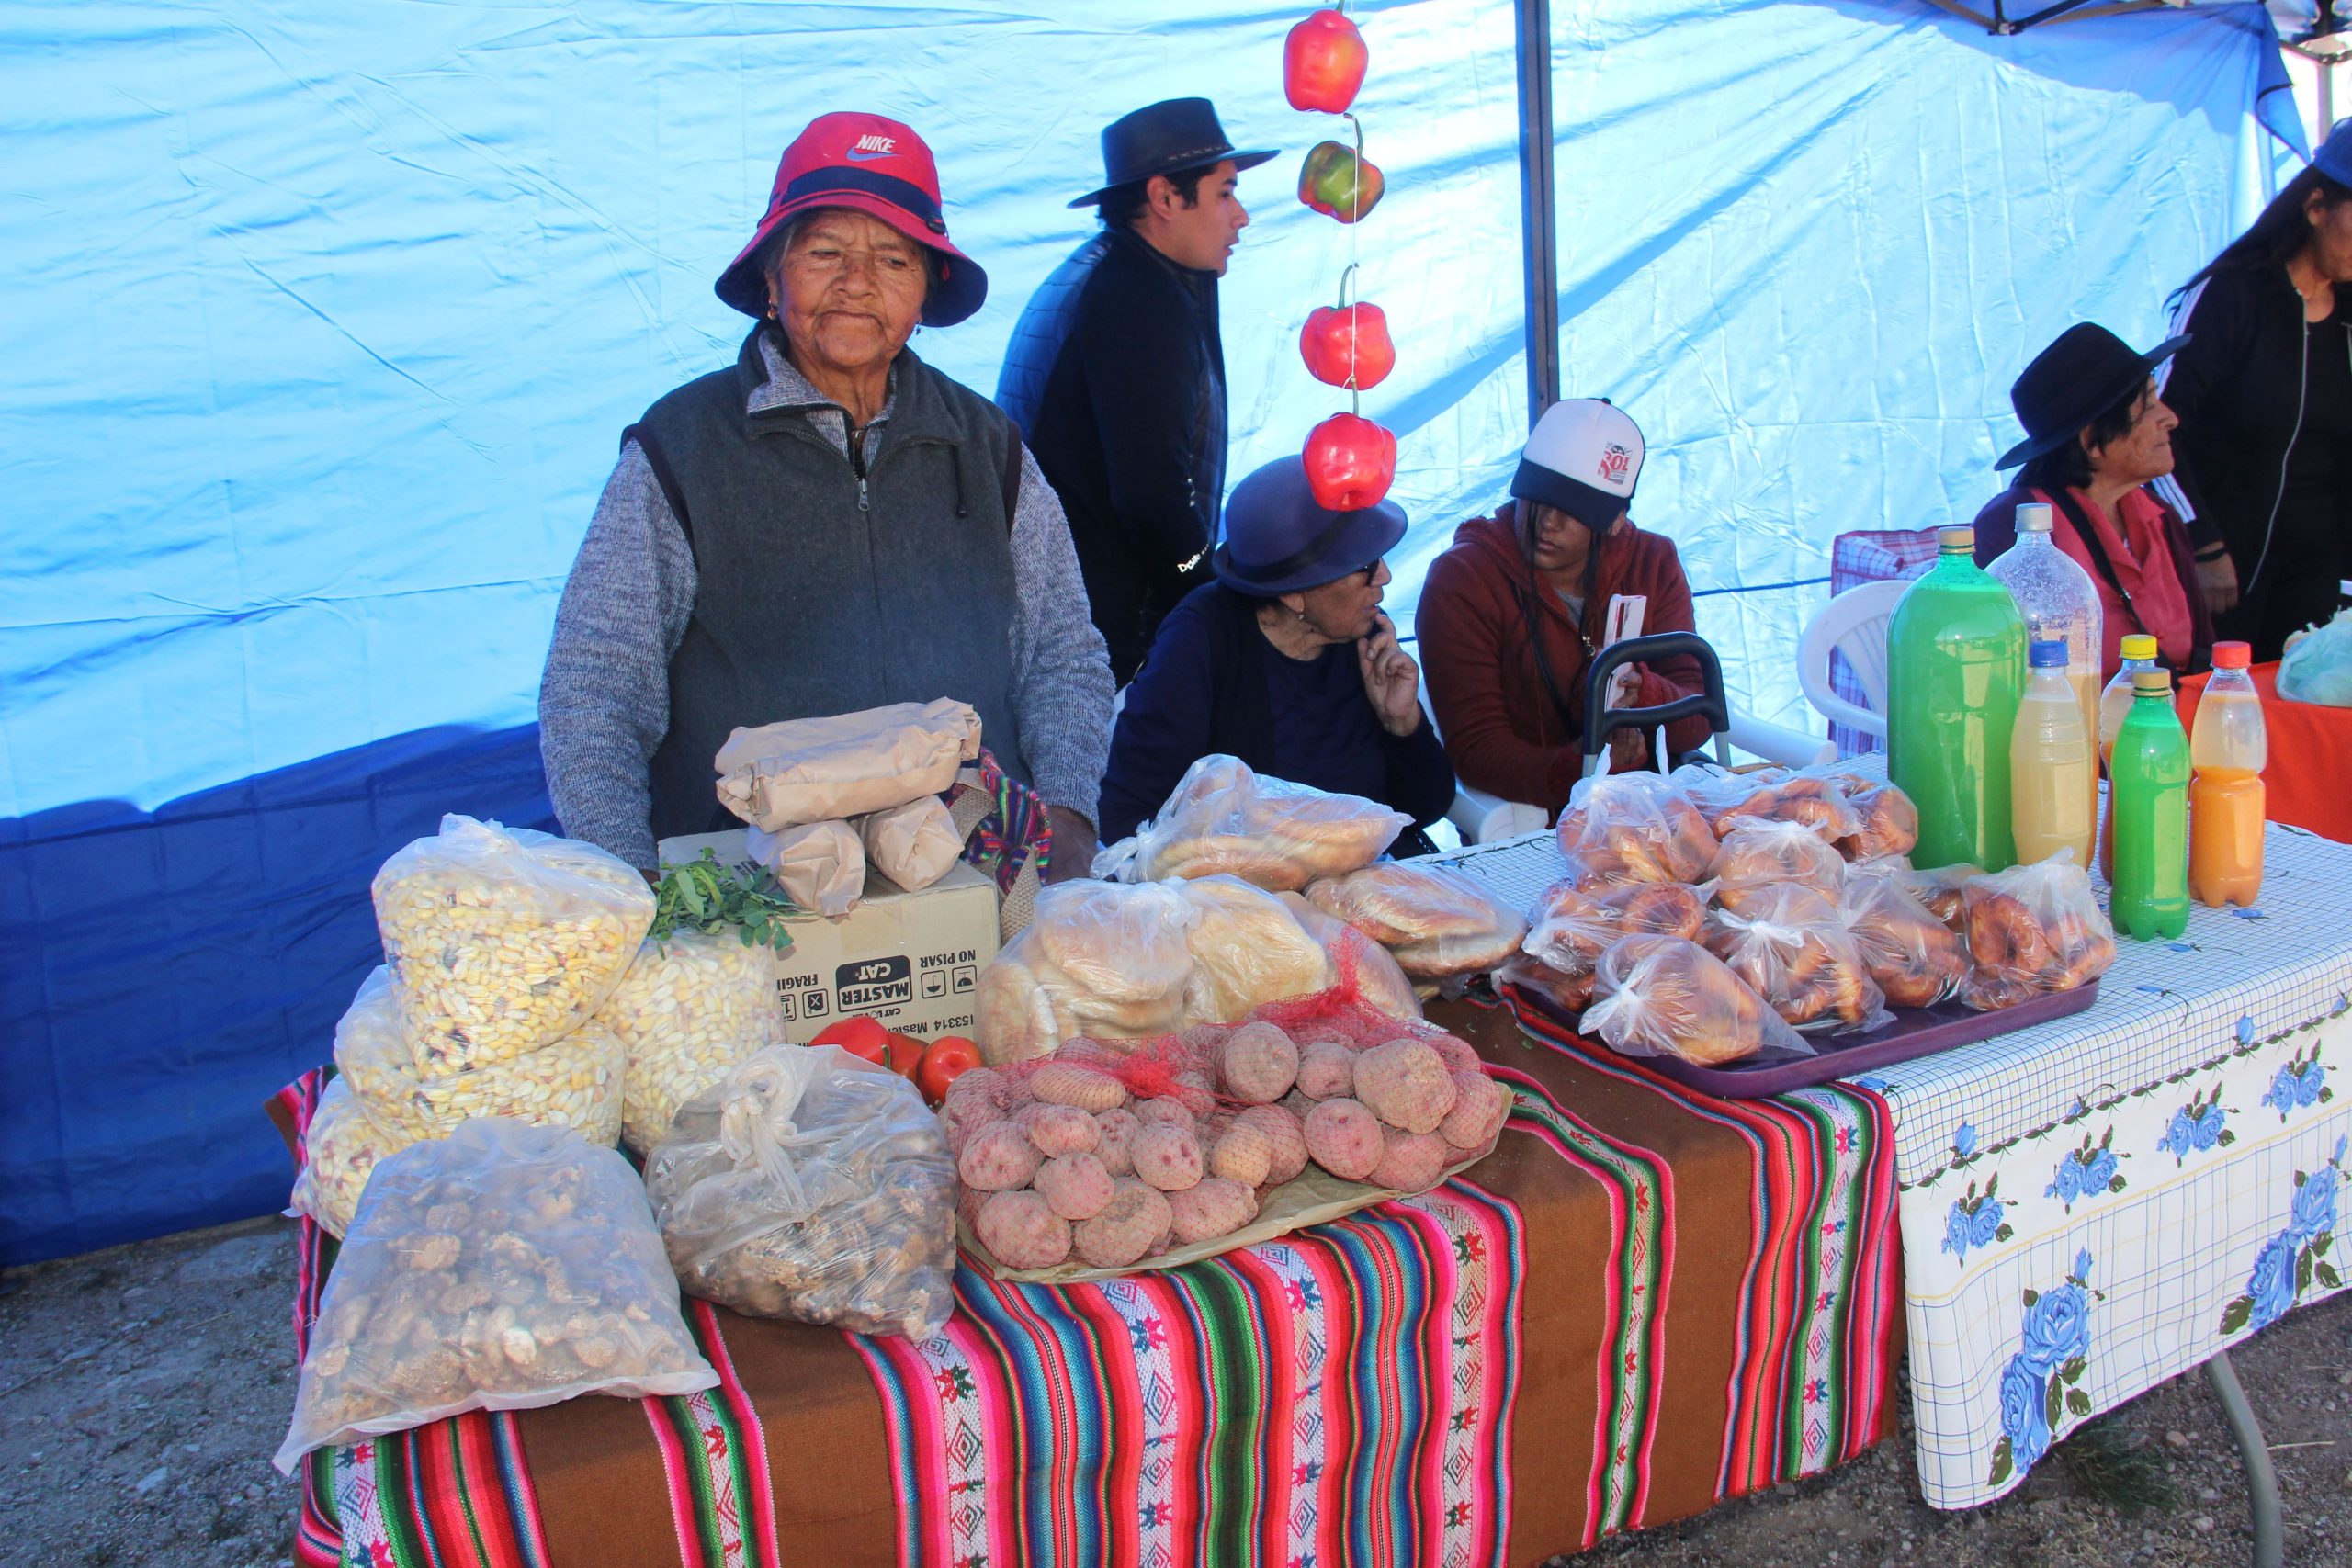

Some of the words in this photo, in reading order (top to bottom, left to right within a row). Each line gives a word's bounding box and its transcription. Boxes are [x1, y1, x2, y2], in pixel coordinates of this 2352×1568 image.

[855, 134, 896, 153] NIKE
[920, 953, 956, 968] PISAR
[958, 949, 976, 962] NO
[858, 962, 891, 981] CAT
[841, 982, 909, 1005] MASTER
[884, 1008, 901, 1017] CAT
